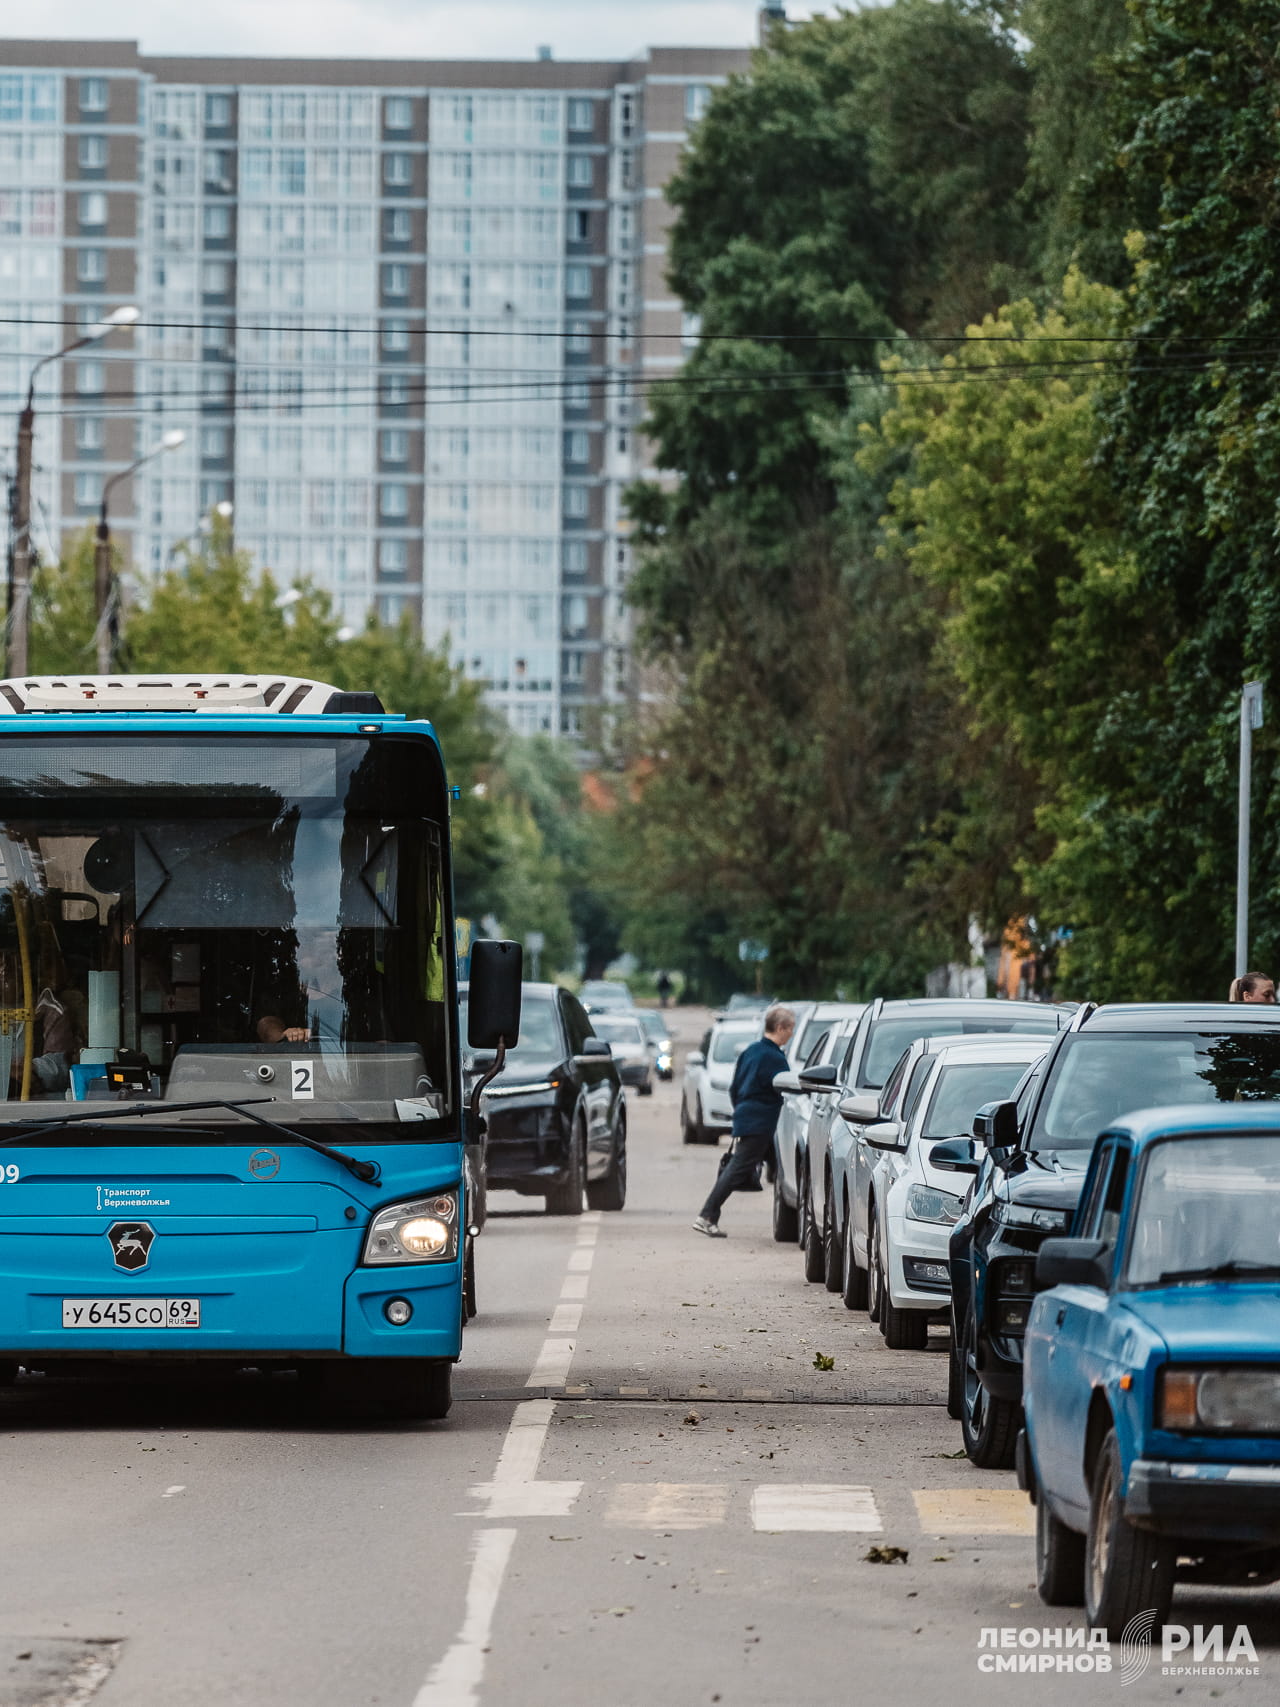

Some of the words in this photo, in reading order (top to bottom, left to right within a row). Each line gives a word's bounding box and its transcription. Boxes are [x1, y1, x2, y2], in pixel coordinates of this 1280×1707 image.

[294, 1068, 312, 1092] 2
[104, 1188, 151, 1198] Транспорт
[104, 1199, 171, 1208] Верхневолжья
[169, 1301, 192, 1318] 69
